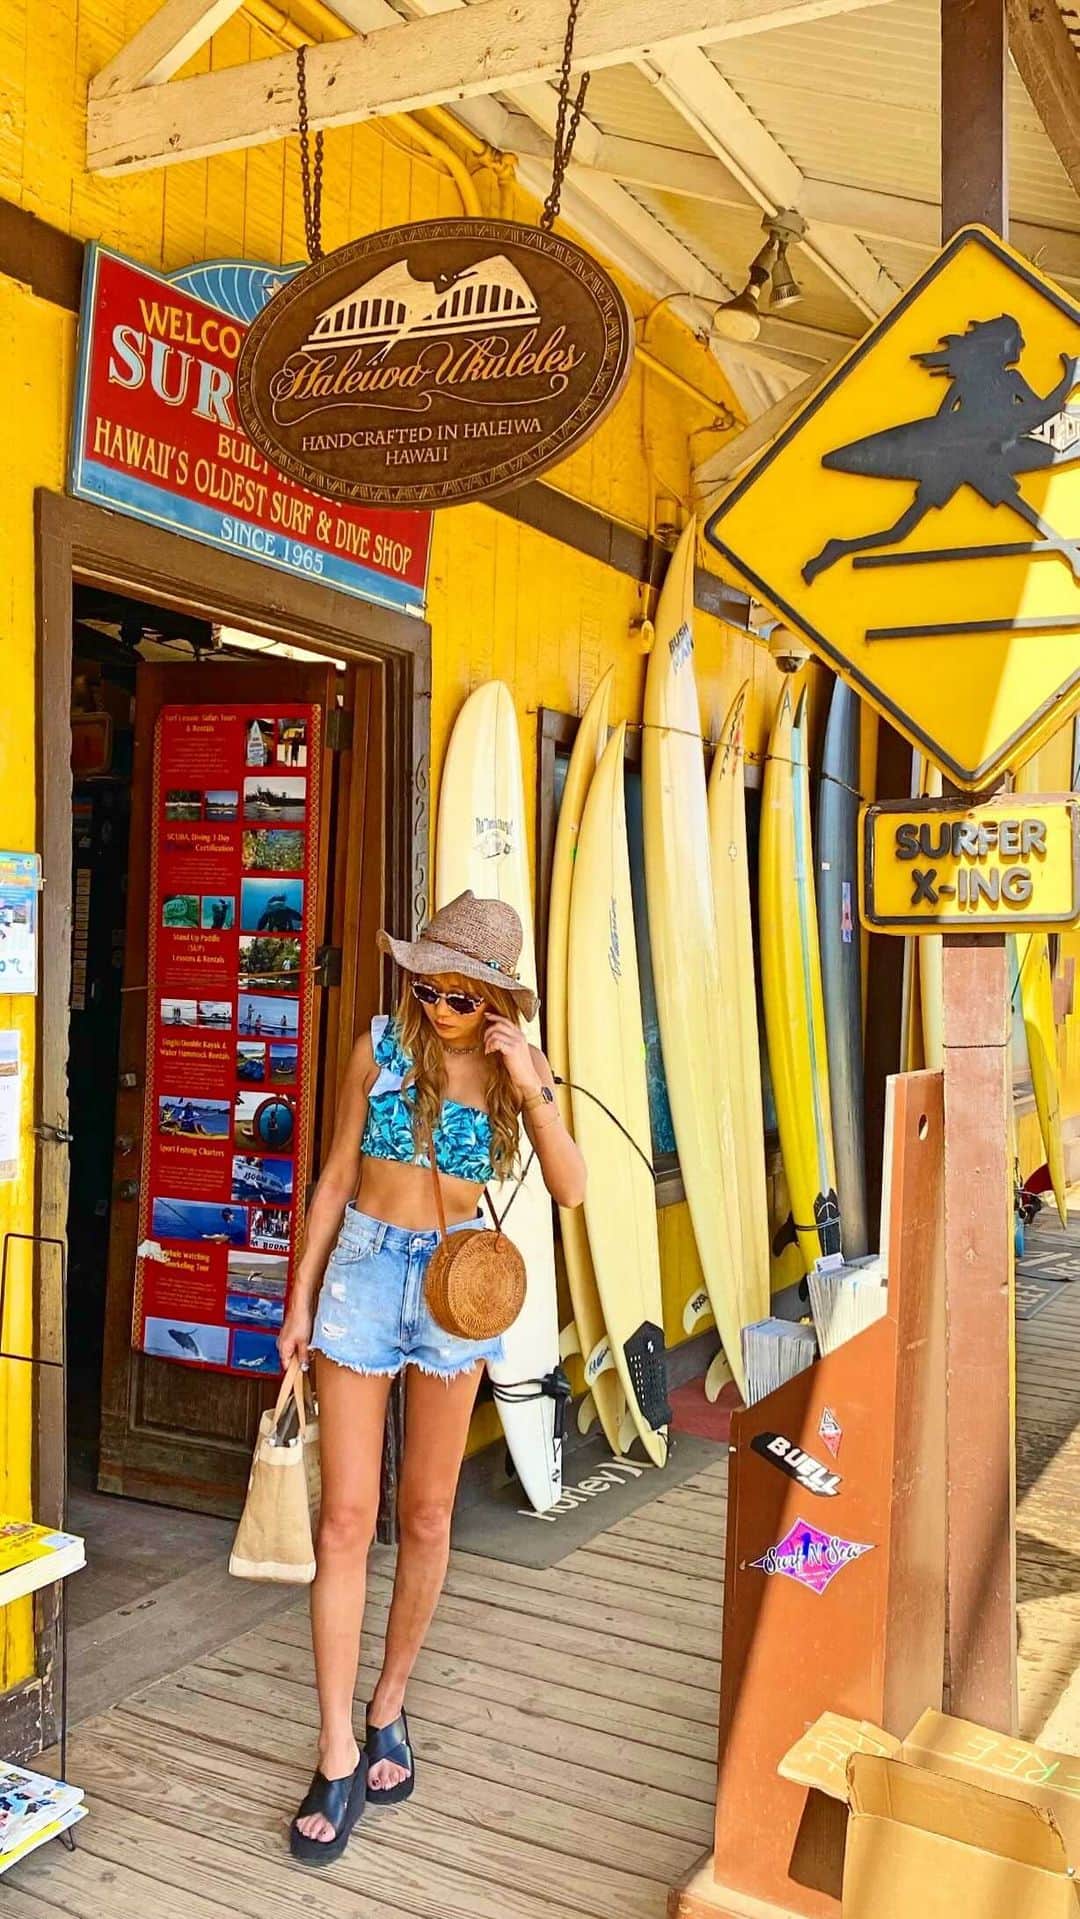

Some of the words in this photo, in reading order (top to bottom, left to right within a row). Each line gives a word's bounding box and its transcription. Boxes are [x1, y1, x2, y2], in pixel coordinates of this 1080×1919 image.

[138, 298, 243, 359] WELCO
[108, 324, 240, 433] SUR
[269, 346, 432, 402] Haleiwa
[417, 325, 586, 386] Ukuleles
[302, 427, 432, 451] HANDCRAFTED
[438, 425, 459, 441] IN
[464, 418, 543, 440] HALEIWA
[386, 447, 448, 466] HAWAII
[94, 417, 189, 486] HAWAII'S
[195, 459, 267, 518] OLDEST
[270, 491, 314, 536] SURF
[316, 511, 332, 543] &
[335, 519, 370, 560] DIVE
[373, 534, 412, 575] SHOP
[220, 517, 276, 557] SINCE
[283, 540, 324, 575] 1965
[896, 819, 1048, 861] SURFER
[911, 867, 1033, 905] X-ING
[767, 1436, 841, 1496] BUELL
[763, 1546, 805, 1575] Surf
[808, 1542, 822, 1565] N
[827, 1536, 860, 1565] Sea
